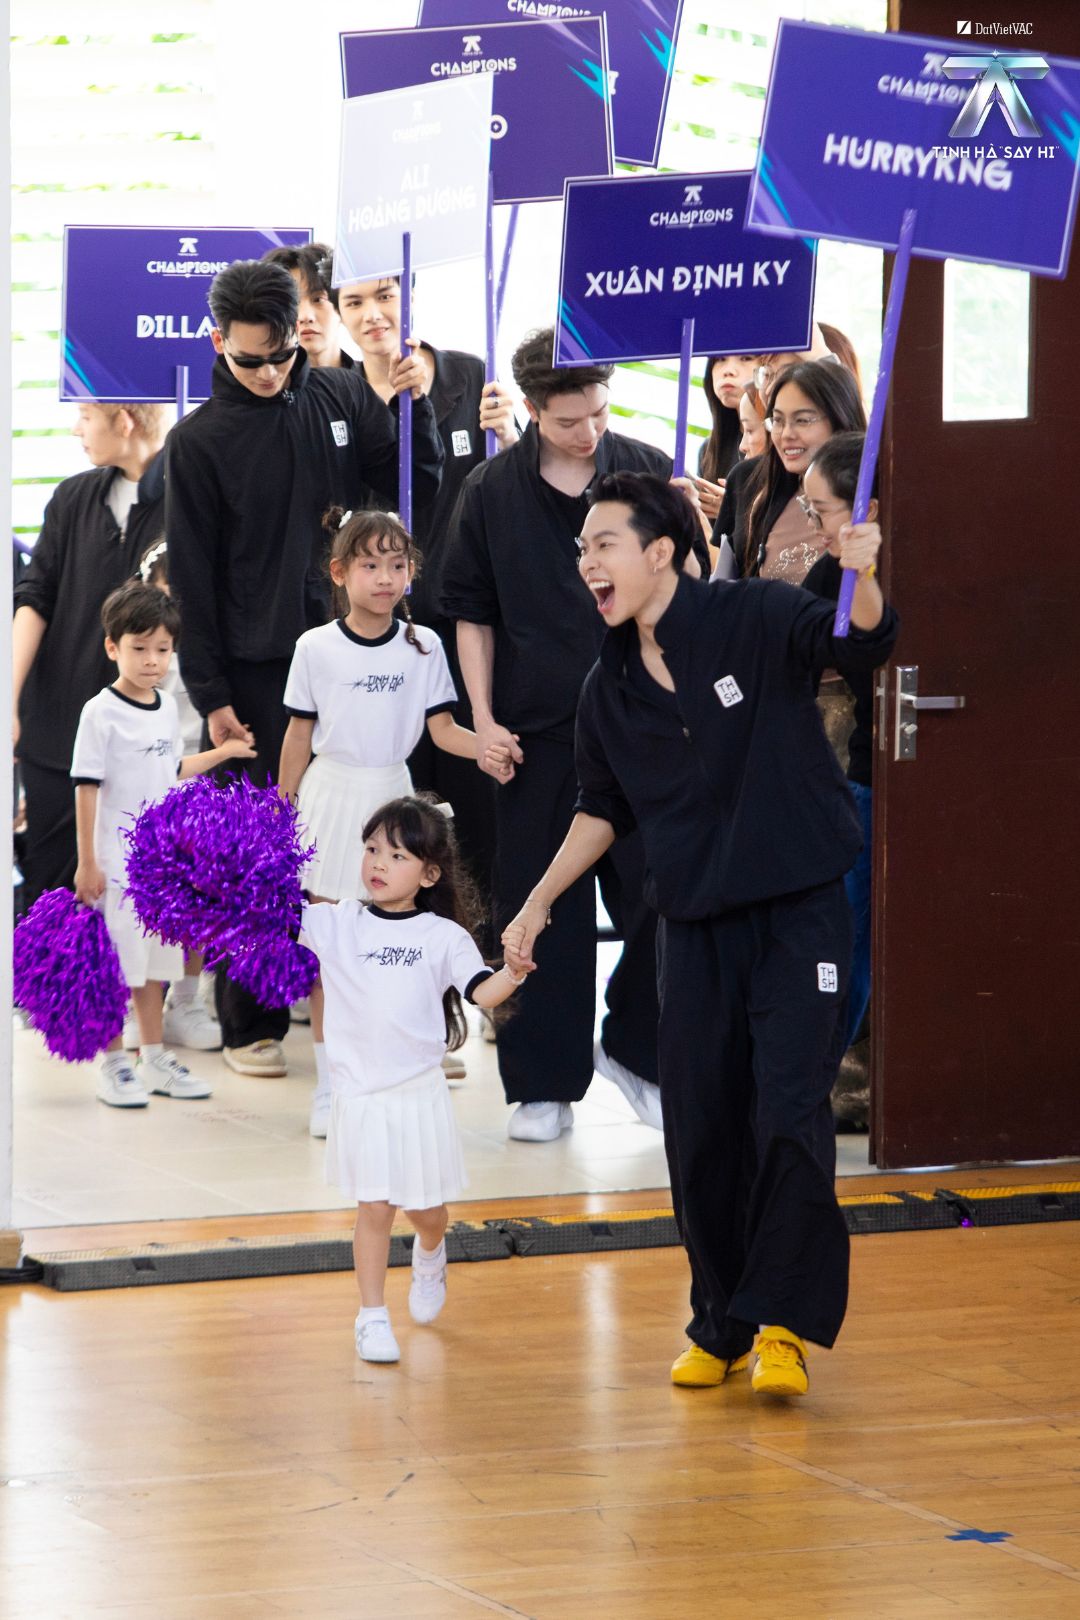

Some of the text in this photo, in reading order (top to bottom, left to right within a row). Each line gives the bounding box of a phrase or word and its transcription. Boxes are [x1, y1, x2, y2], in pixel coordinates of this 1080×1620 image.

[430, 57, 517, 76] CHAMPIONS
[877, 74, 974, 105] CHAMPION
[823, 133, 1013, 192] HURRYKNG
[400, 163, 431, 193] ALI
[348, 194, 411, 234] HOÀNG
[650, 208, 734, 227] CHAMPIONS
[584, 260, 791, 298] XUÂN ĐỊNH KY
[136, 314, 213, 339] DILLA
[455, 434, 466, 443] TH
[456, 444, 468, 453] SH
[717, 680, 735, 693] TH
[724, 690, 740, 704] SH
[383, 946, 406, 957] TINH
[820, 966, 835, 977] TH
[822, 978, 835, 989] SH
